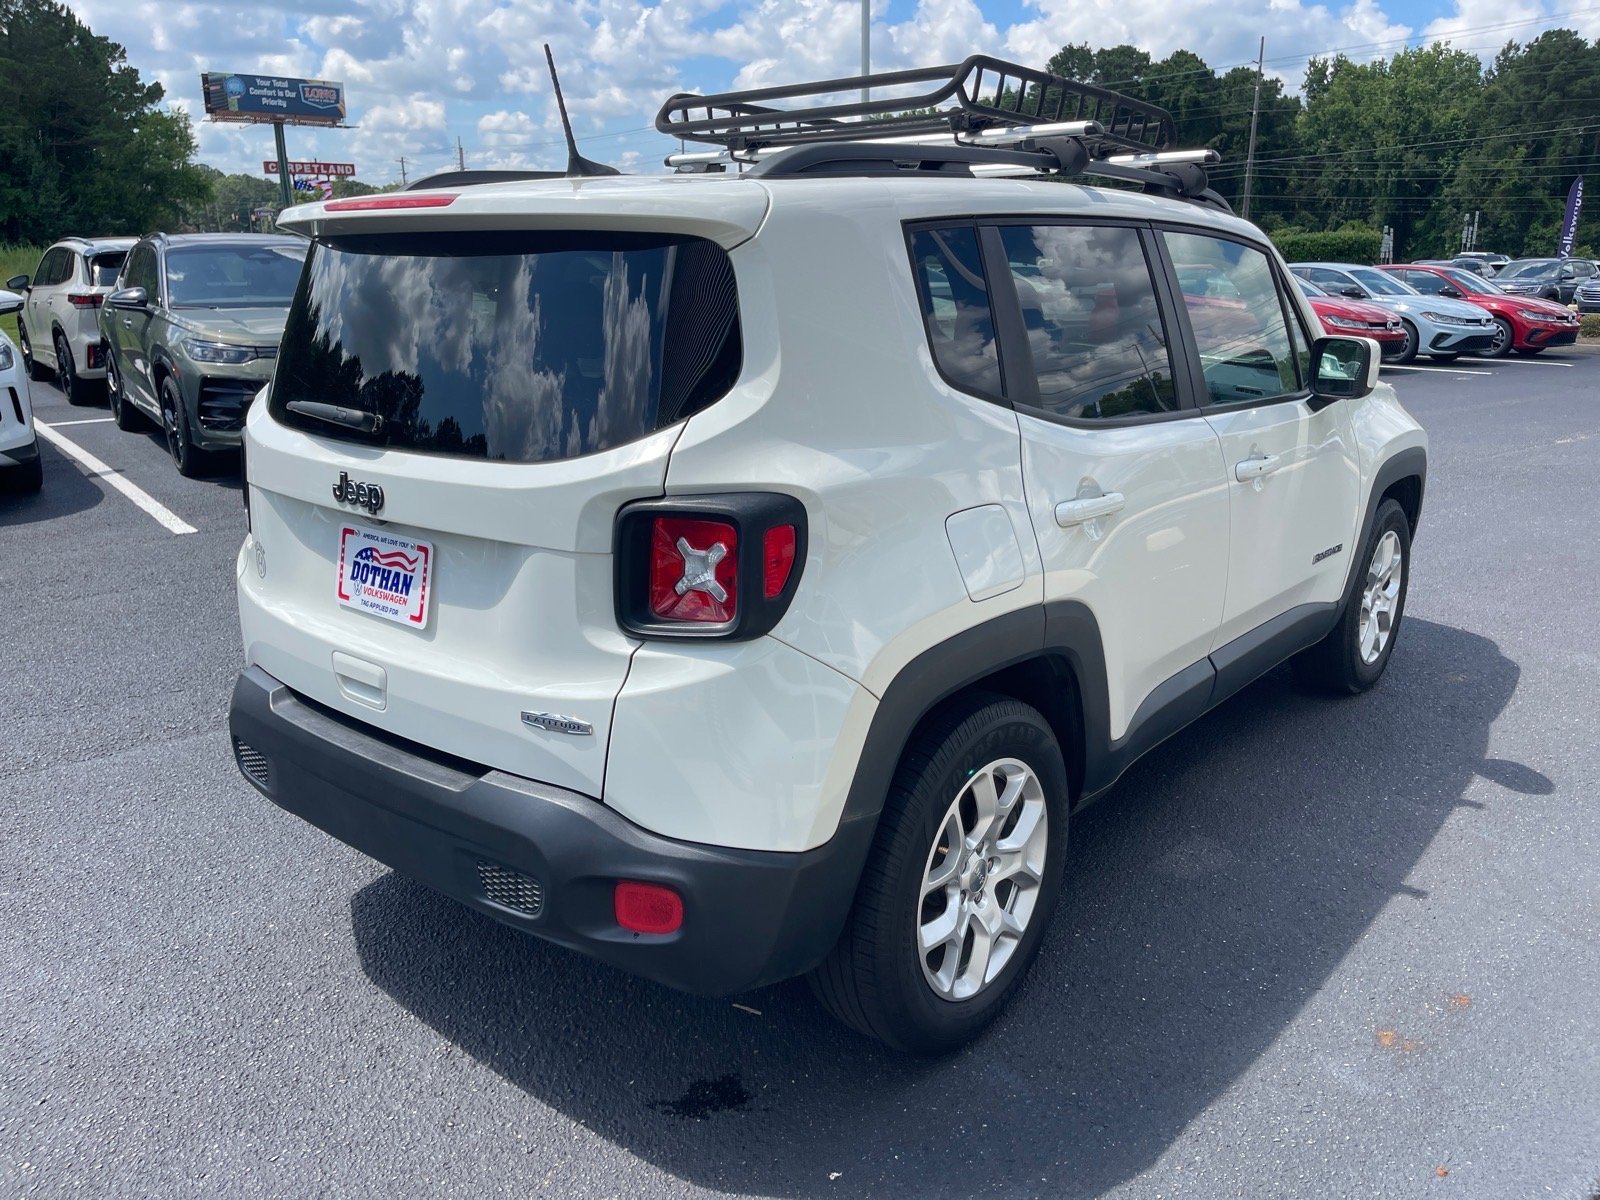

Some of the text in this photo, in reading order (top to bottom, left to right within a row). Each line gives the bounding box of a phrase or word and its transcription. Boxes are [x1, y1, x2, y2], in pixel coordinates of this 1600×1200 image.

[256, 78, 288, 87] Your Total
[249, 87, 276, 96] Comfort
[262, 97, 287, 108] Priority
[269, 163, 353, 174] CRPETLAND
[332, 471, 384, 515] Jeep
[350, 560, 414, 597] DOTHAN
[363, 586, 408, 606] VOLKSWAGEN
[361, 599, 370, 607] TAG
[369, 602, 389, 612] APPLIED
[389, 607, 399, 616] FOR
